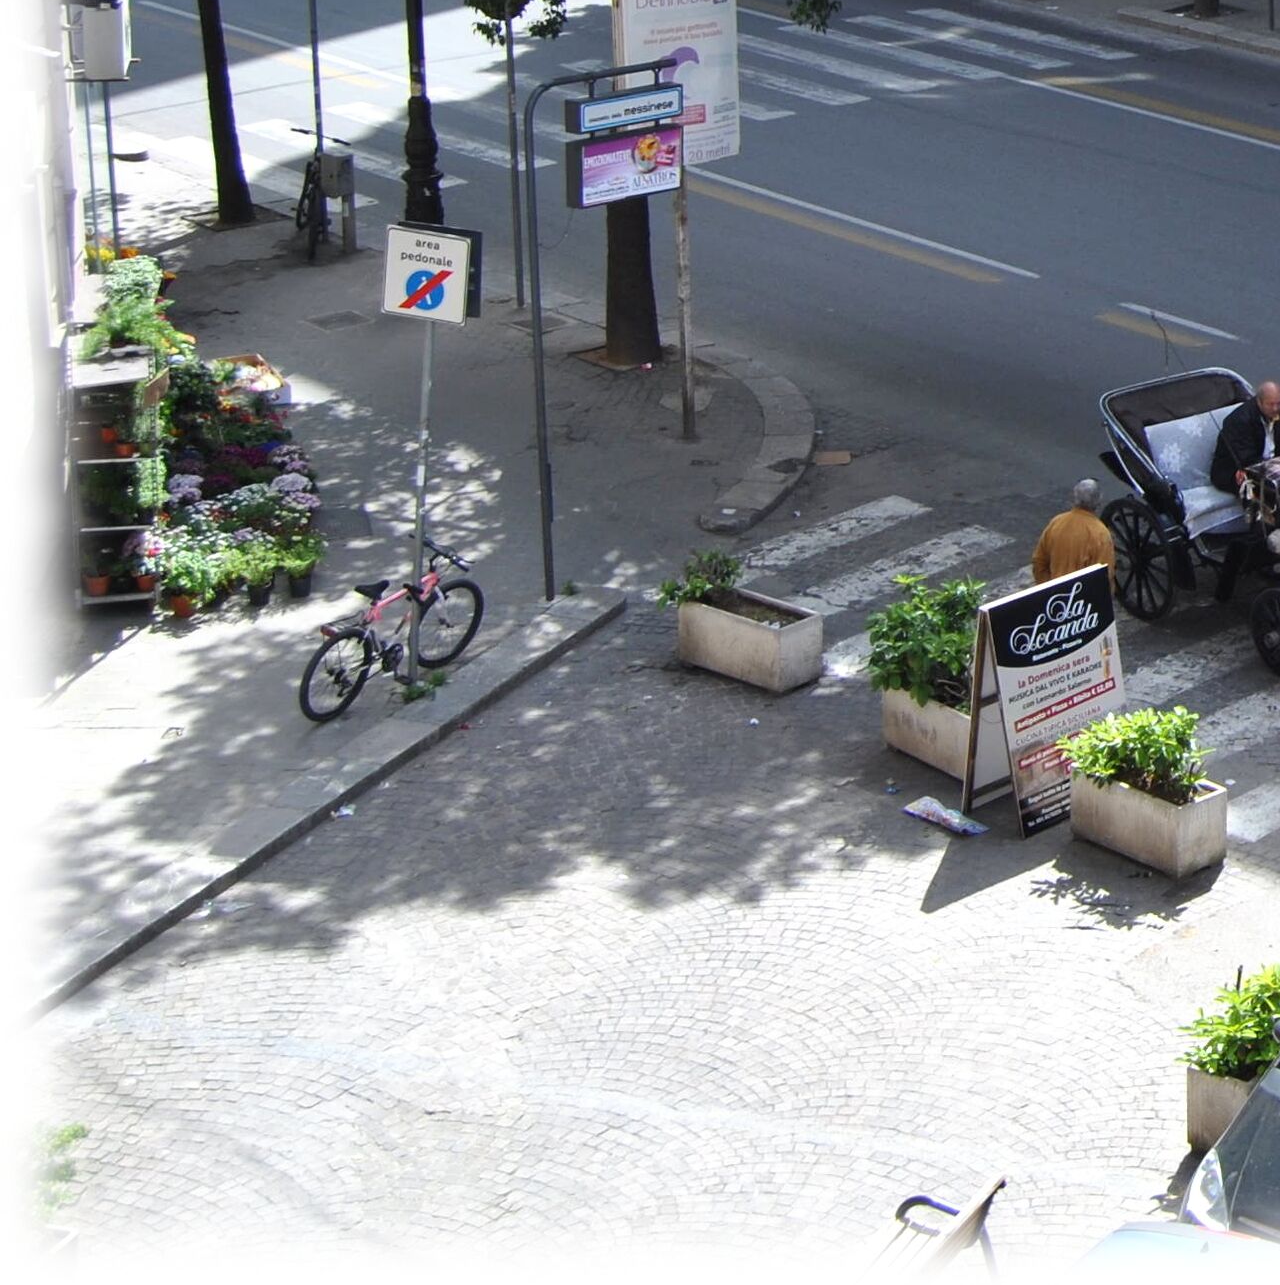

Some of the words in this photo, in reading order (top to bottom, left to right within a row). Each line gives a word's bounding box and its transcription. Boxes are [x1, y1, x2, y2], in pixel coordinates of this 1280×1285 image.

[689, 148, 704, 162] 20
[415, 239, 440, 251] area
[400, 251, 453, 267] pedonale
[1047, 581, 1085, 623] La
[1009, 602, 1099, 655] Locanda
[1028, 663, 1071, 685] Domenica
[1035, 683, 1048, 694] DAL
[1048, 675, 1065, 688] VIVO
